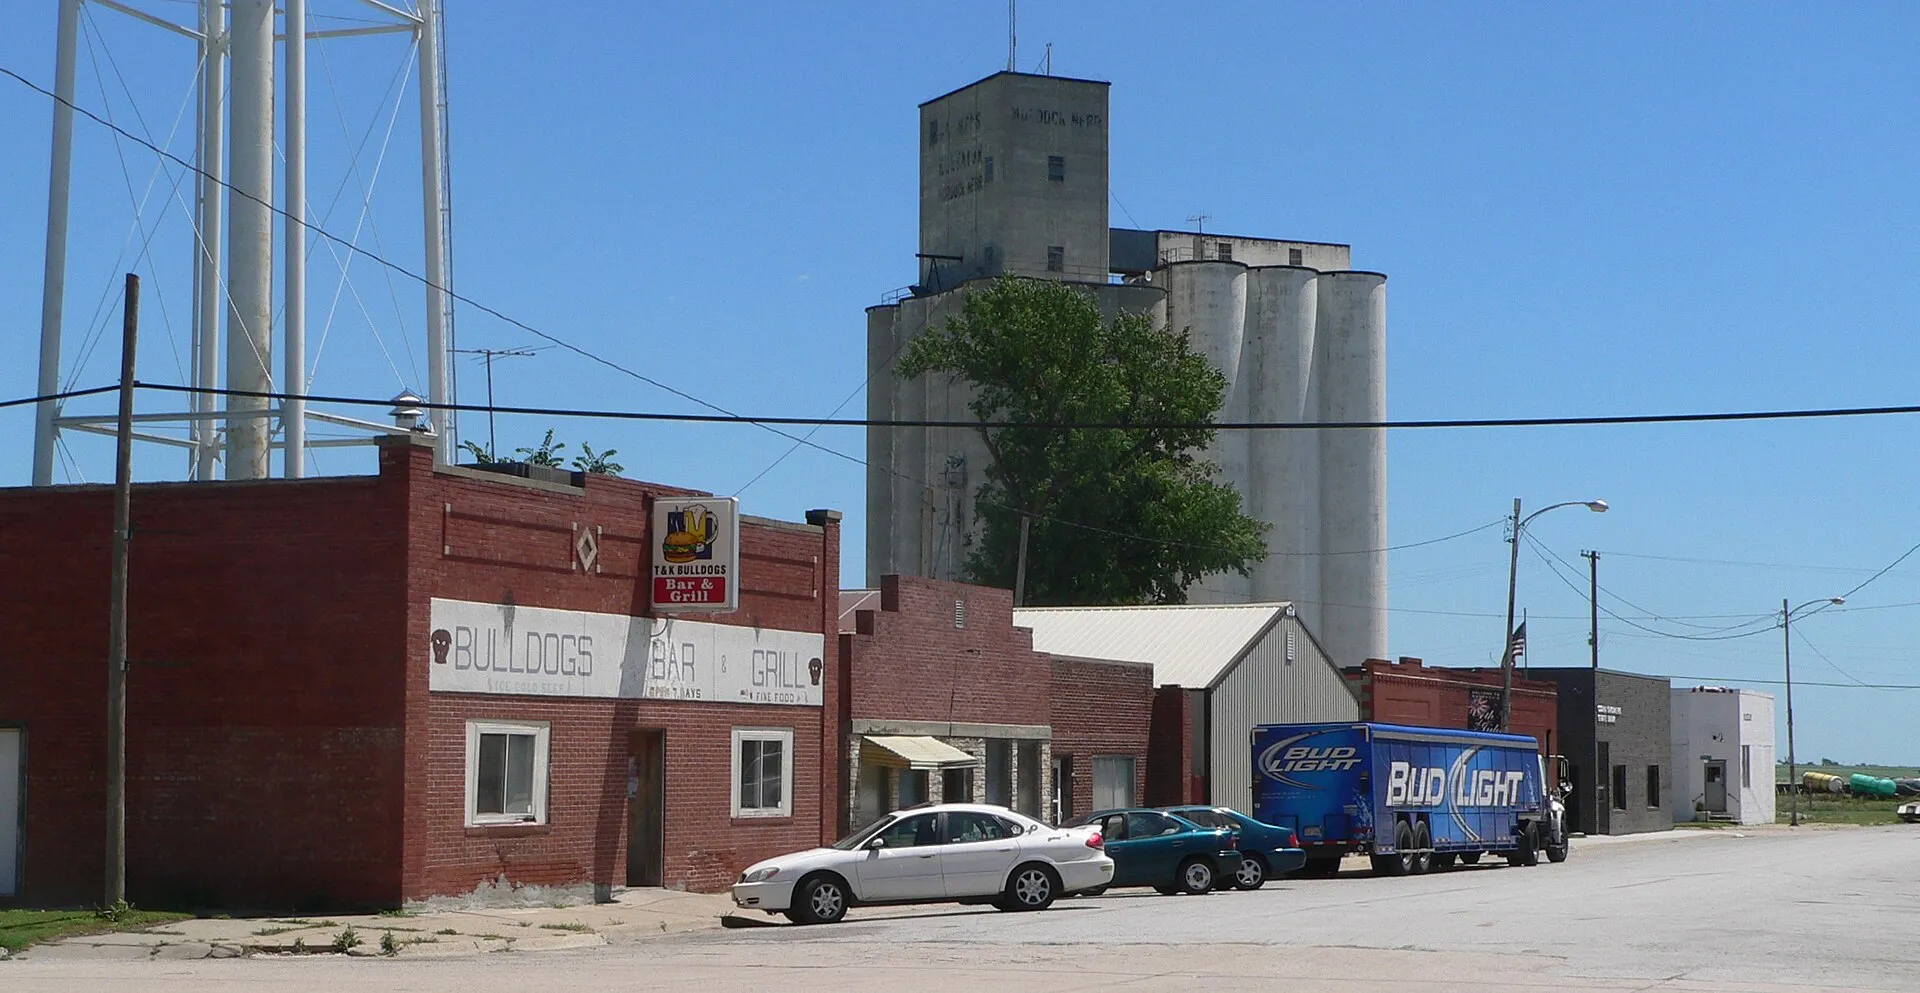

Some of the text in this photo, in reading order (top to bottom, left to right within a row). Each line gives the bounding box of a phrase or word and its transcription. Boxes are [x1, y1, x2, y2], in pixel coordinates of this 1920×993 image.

[655, 564, 727, 576] T&K BULLDOGS
[665, 578, 714, 590] Bar &
[670, 590, 708, 602] Grill
[455, 626, 806, 688] BULLDOGS BAR & GRILL
[774, 692, 795, 703] FOOD
[1284, 747, 1356, 759] BUD
[1267, 759, 1362, 772] LIGHT
[1386, 761, 1524, 807] BUD LIGHT
